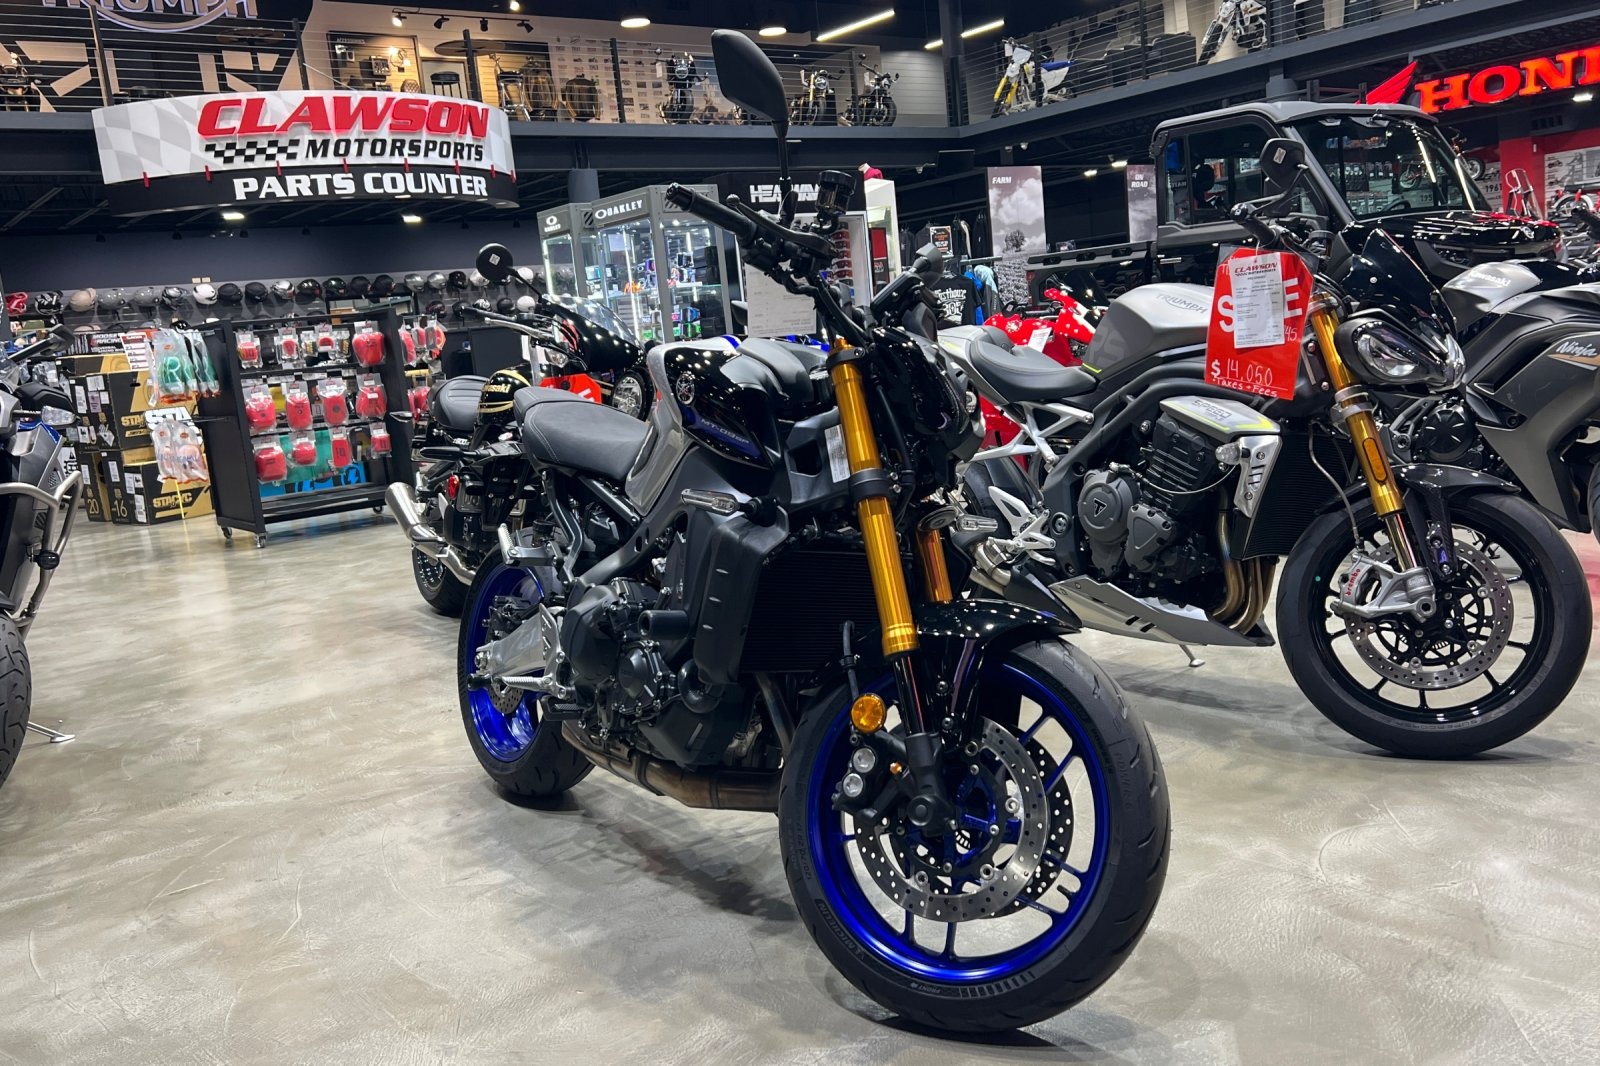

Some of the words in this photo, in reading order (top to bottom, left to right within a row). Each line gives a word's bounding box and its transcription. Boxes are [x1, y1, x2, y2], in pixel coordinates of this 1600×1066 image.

[198, 96, 489, 138] CLAWSON
[305, 138, 484, 162] MOTORSPORTS
[233, 173, 355, 201] PARTS
[363, 171, 488, 197] COUNTER
[992, 176, 1012, 185] FARM
[607, 199, 643, 217] OAKLEY
[1234, 262, 1278, 274] CLAWSON
[1469, 271, 1512, 288] Kawasaki
[1155, 293, 1208, 314] TRIUMPH
[1217, 277, 1303, 333] SE
[1555, 341, 1598, 357] Ninja
[1210, 359, 1221, 378] $
[1252, 384, 1278, 397] Fees
[1192, 399, 1232, 418] SPEED
[701, 418, 736, 439] MT-09
[152, 492, 193, 509] STACYC
[1344, 568, 1361, 596] brembo
[817, 900, 856, 949] MICHELIN
